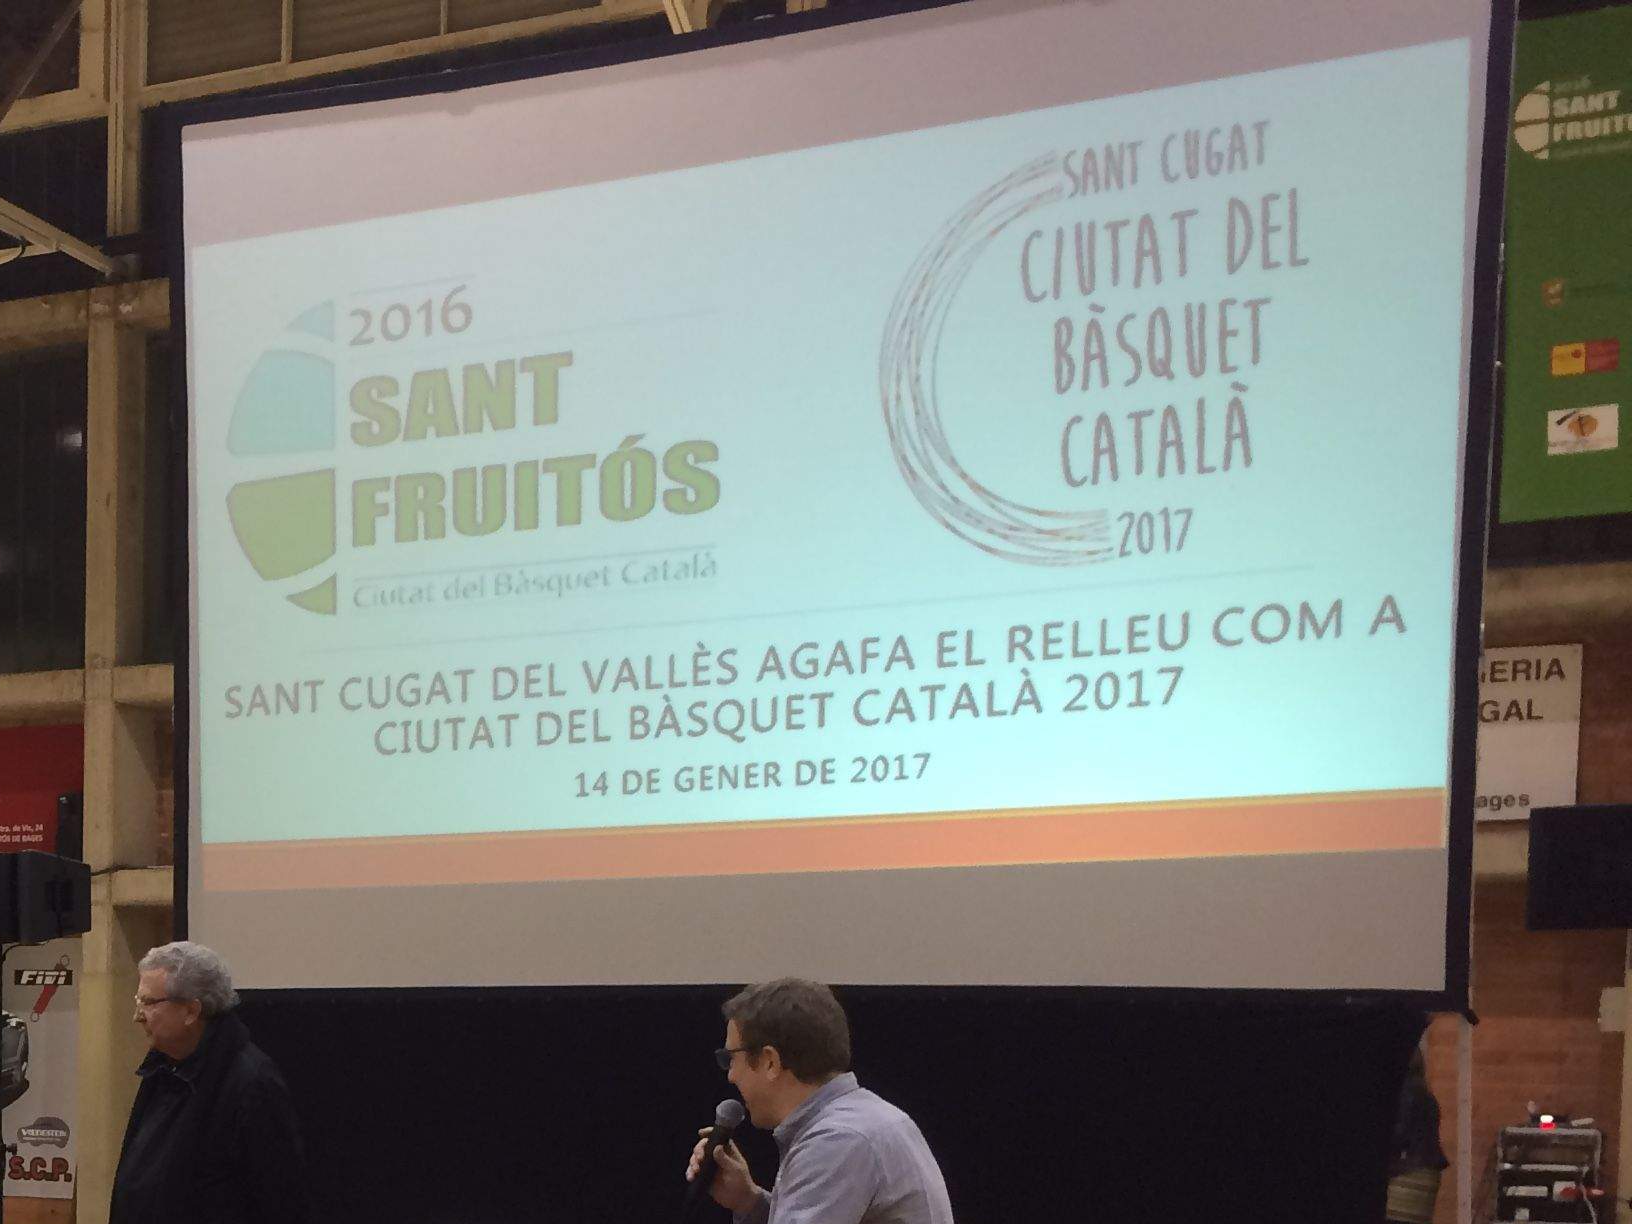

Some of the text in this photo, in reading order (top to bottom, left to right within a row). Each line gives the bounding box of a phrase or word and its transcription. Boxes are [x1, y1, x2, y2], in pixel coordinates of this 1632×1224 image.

[1553, 90, 1620, 118] SANT
[1553, 112, 1632, 142] FRUIT
[1063, 120, 1270, 199] SANT CUGAT
[1020, 187, 1310, 303] CIUTAT DEL
[349, 283, 473, 346] 2016
[1054, 297, 1271, 396] BÀSQUET
[349, 350, 573, 447] SANT
[1060, 381, 1253, 488] CATALÀ
[352, 432, 720, 547] FRUITÓS
[1117, 507, 1193, 558] 2017
[353, 552, 719, 609] Ciutat del Bàsquet Català
[225, 594, 1408, 719] SANT CUGAT DEL VALLÈS AGAFA EL RELLEU COM A
[373, 665, 1185, 756] CIUTAT DEL BÀSQUET CATALÀ 2017
[574, 752, 932, 798] 14 DE GENER DE 2017
[7, 1156, 73, 1183] S.C.P.
